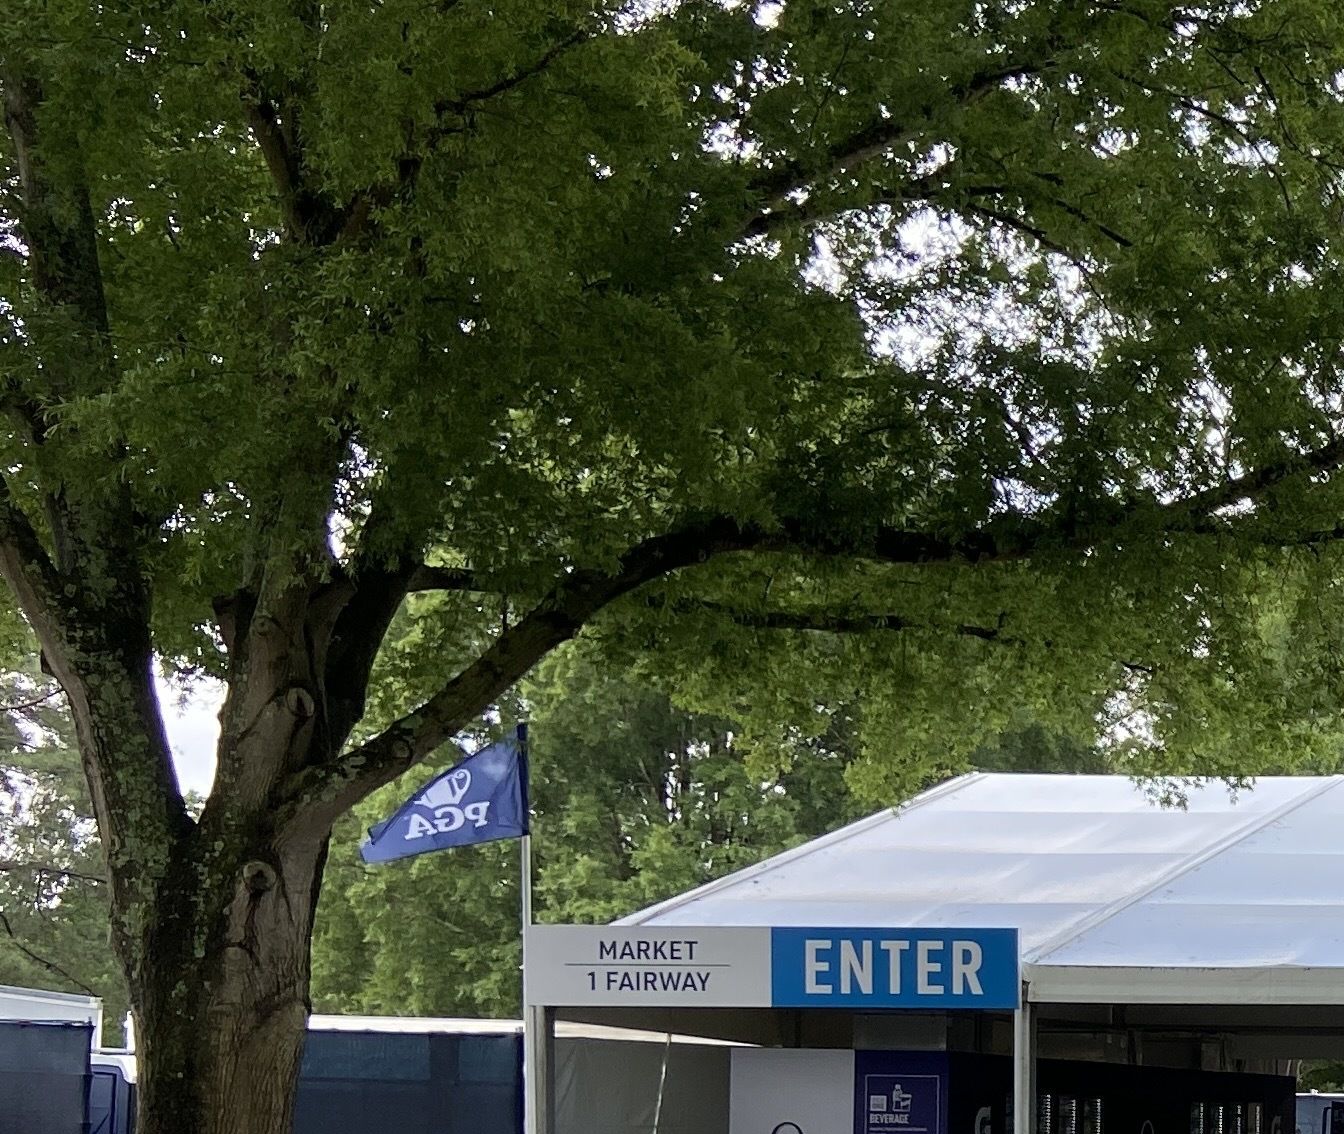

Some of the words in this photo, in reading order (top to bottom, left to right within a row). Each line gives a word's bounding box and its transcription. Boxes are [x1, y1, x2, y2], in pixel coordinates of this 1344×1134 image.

[599, 941, 698, 960] MARKET
[805, 940, 984, 995] ENTER
[587, 972, 596, 991] 1
[607, 972, 710, 992] FAIRWAY
[869, 1113, 910, 1124] BEVERAGE
